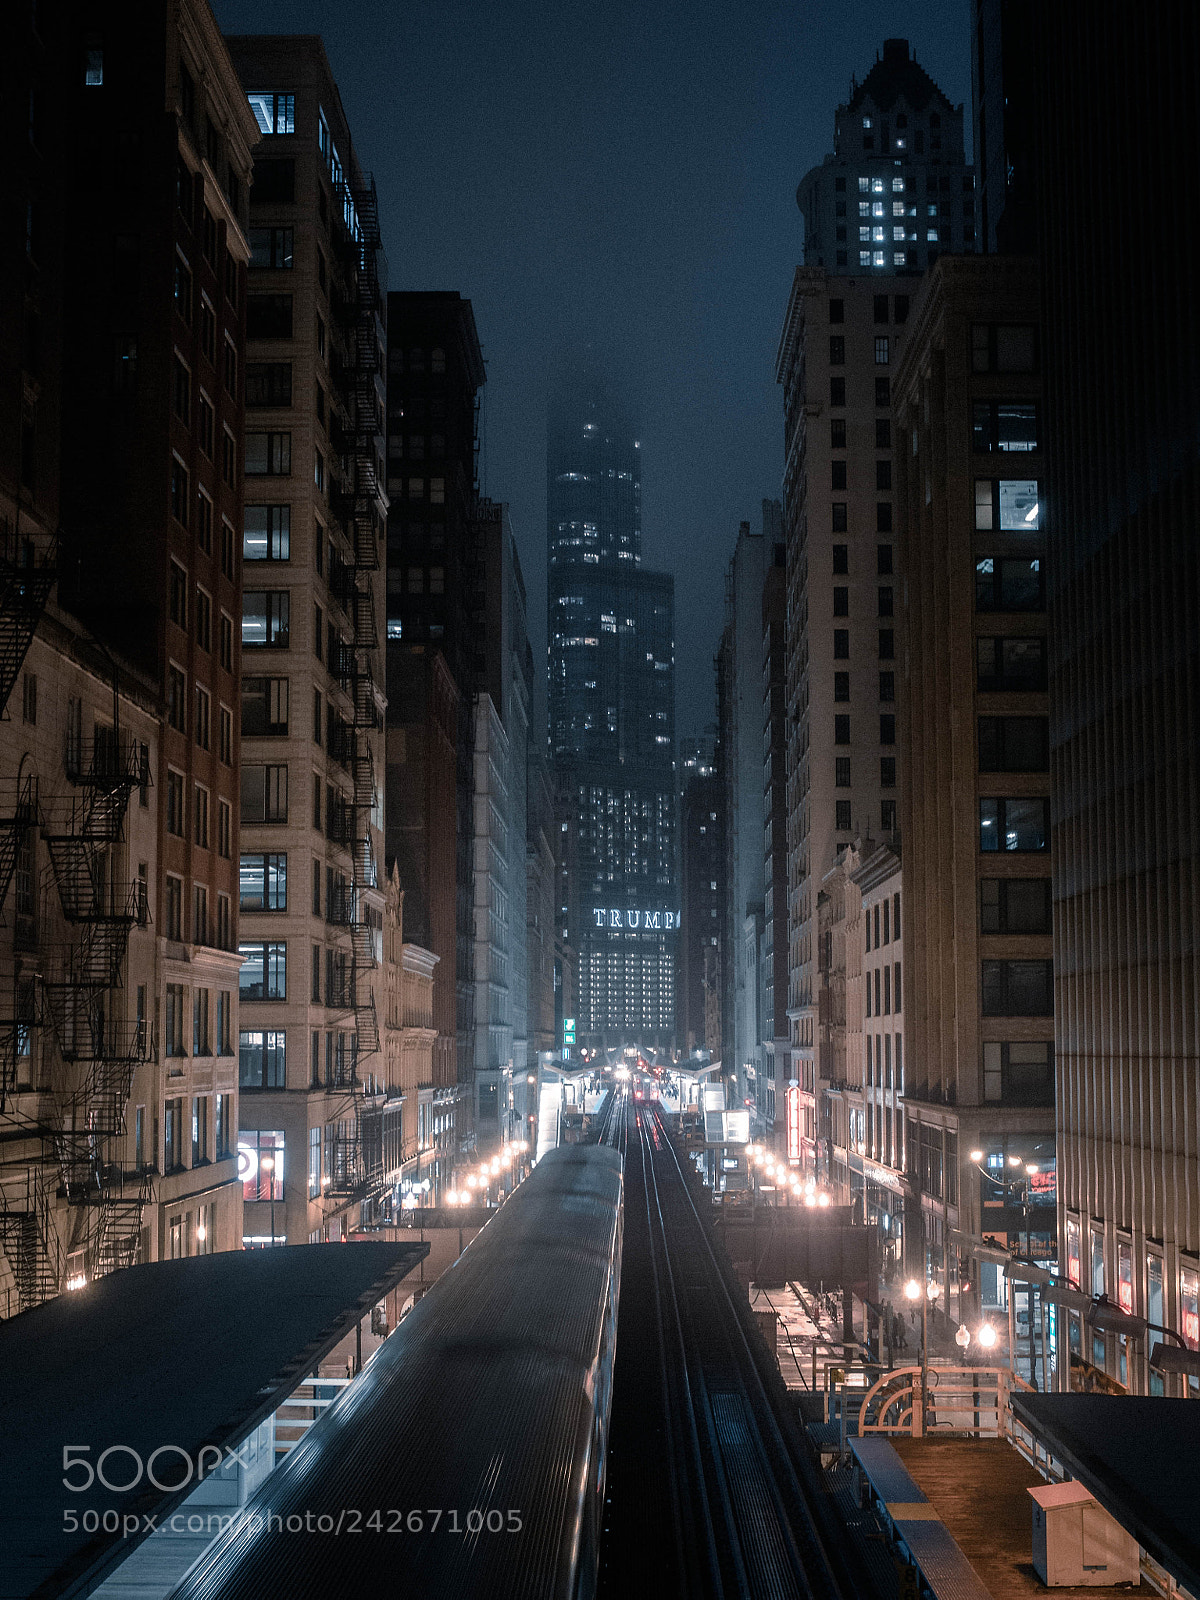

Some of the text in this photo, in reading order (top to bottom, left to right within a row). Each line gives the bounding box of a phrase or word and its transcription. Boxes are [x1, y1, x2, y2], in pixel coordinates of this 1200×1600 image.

[593, 908, 675, 930] TRUMP
[1009, 1239, 1037, 1249] Schol
[1019, 1248, 1053, 1258] Cicago
